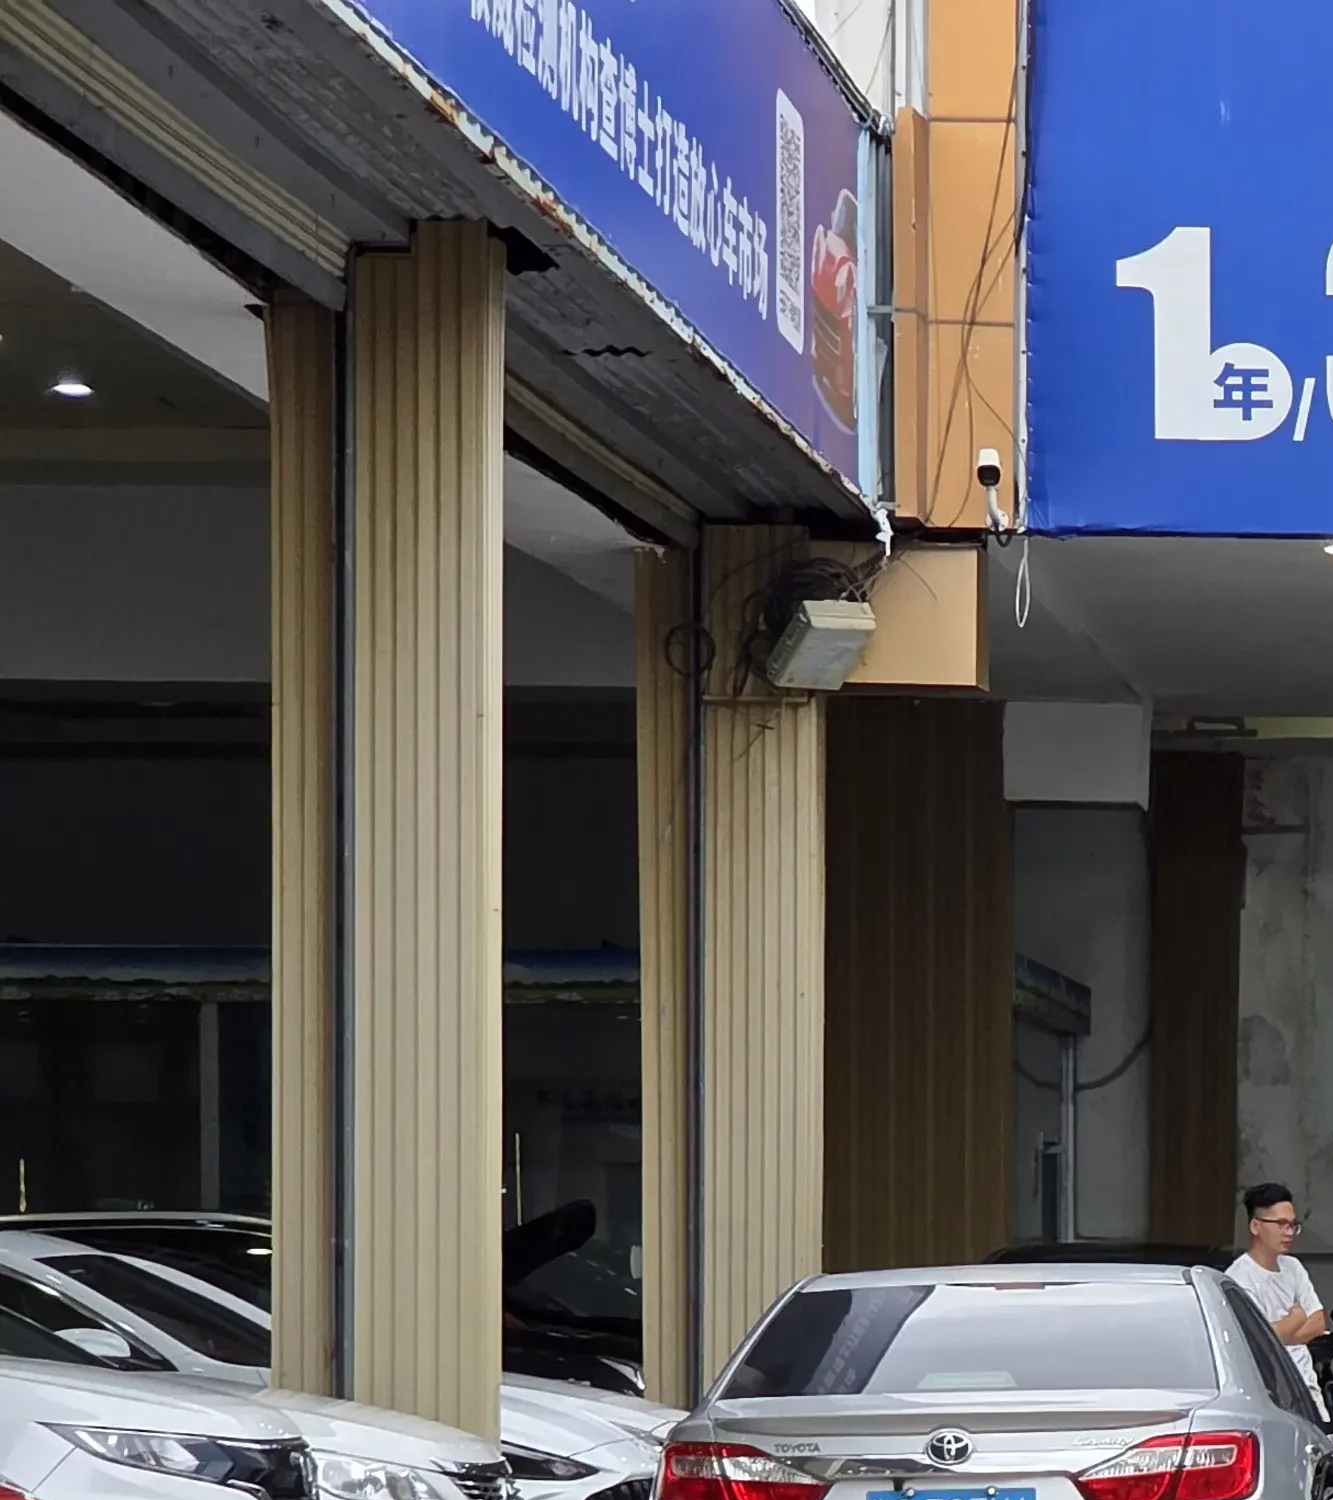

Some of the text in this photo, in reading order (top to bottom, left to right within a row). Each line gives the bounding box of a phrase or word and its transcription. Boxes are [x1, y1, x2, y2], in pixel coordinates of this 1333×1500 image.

[471, 0, 769, 321] 检测机构查博士打造放心车市场
[773, 1443, 822, 1453] TOYOTA
